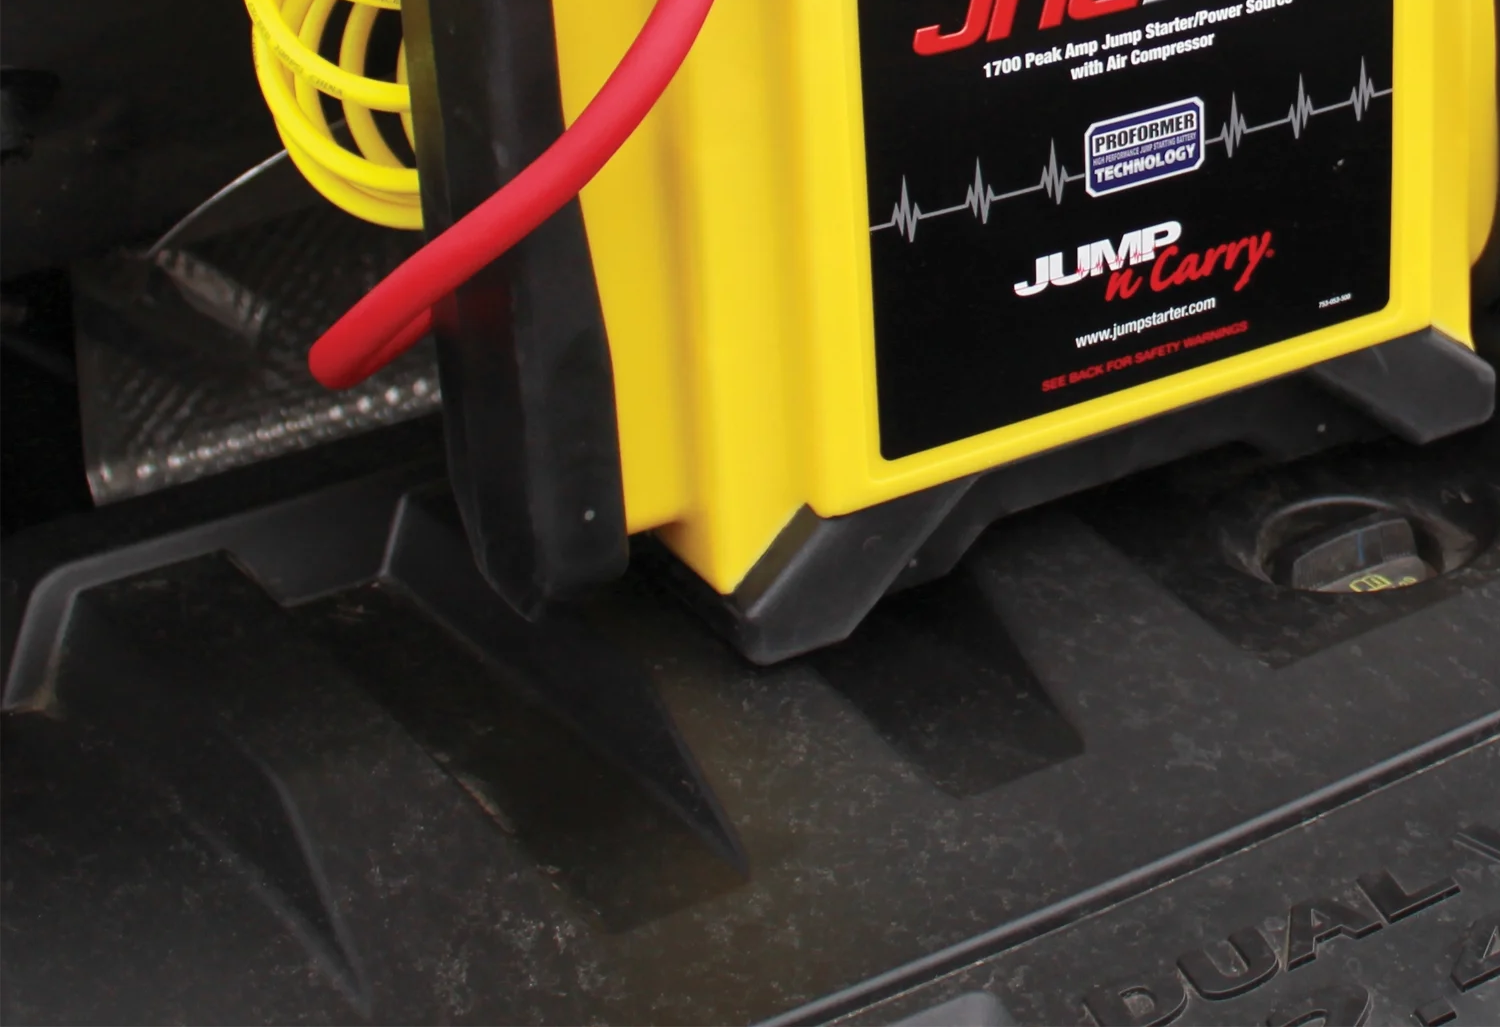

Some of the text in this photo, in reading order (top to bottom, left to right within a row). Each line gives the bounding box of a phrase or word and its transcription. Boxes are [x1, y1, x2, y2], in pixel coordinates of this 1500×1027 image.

[983, 55, 1021, 78] 1700
[1025, 47, 1062, 70] Peak
[1064, 39, 1098, 60] Amp
[1101, 28, 1142, 52] Jump
[1145, 2, 1243, 40] Starter/Power
[1071, 32, 1215, 81] with Air Compressor
[1094, 112, 1195, 154] PROFORMER
[1094, 143, 1196, 183] TECHNOLOGY
[1176, 132, 1196, 144] BATTERY
[1014, 220, 1182, 297] JUMP
[1105, 230, 1272, 302] n Carry
[1075, 296, 1217, 348] www.jumpstarter.com
[1041, 320, 1249, 392] SEE BACK FOR SAFETY WARNINGS
[1080, 867, 1461, 1027] DUAL
